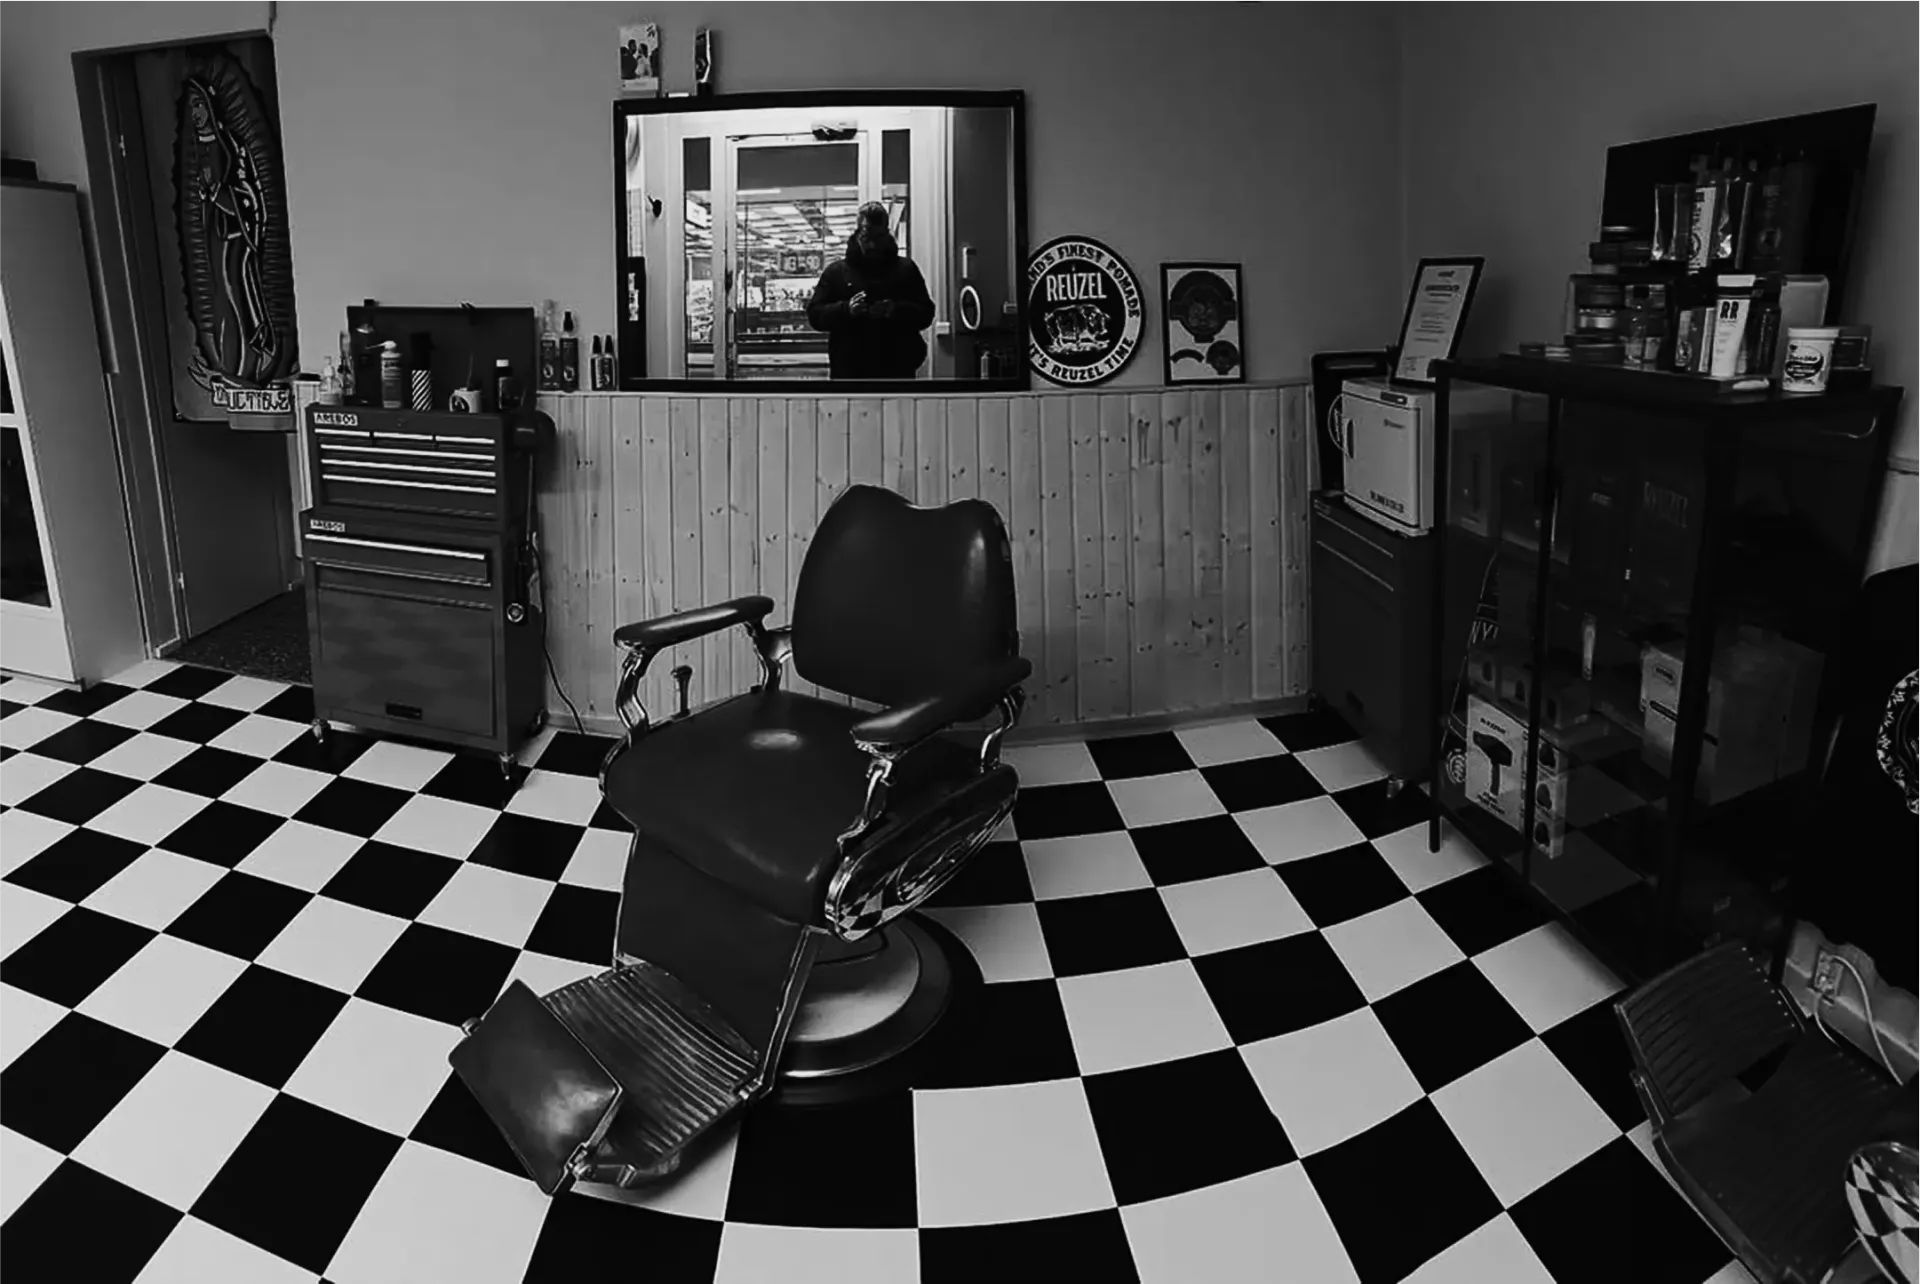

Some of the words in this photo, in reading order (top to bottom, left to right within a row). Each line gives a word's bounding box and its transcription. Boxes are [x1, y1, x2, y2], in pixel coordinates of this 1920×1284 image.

[1057, 244, 1105, 263] FINEST
[1105, 259, 1140, 318] POMADE
[1720, 301, 1739, 319] RR
[1051, 365, 1104, 381] REUZEL
[1104, 337, 1134, 370] TIME
